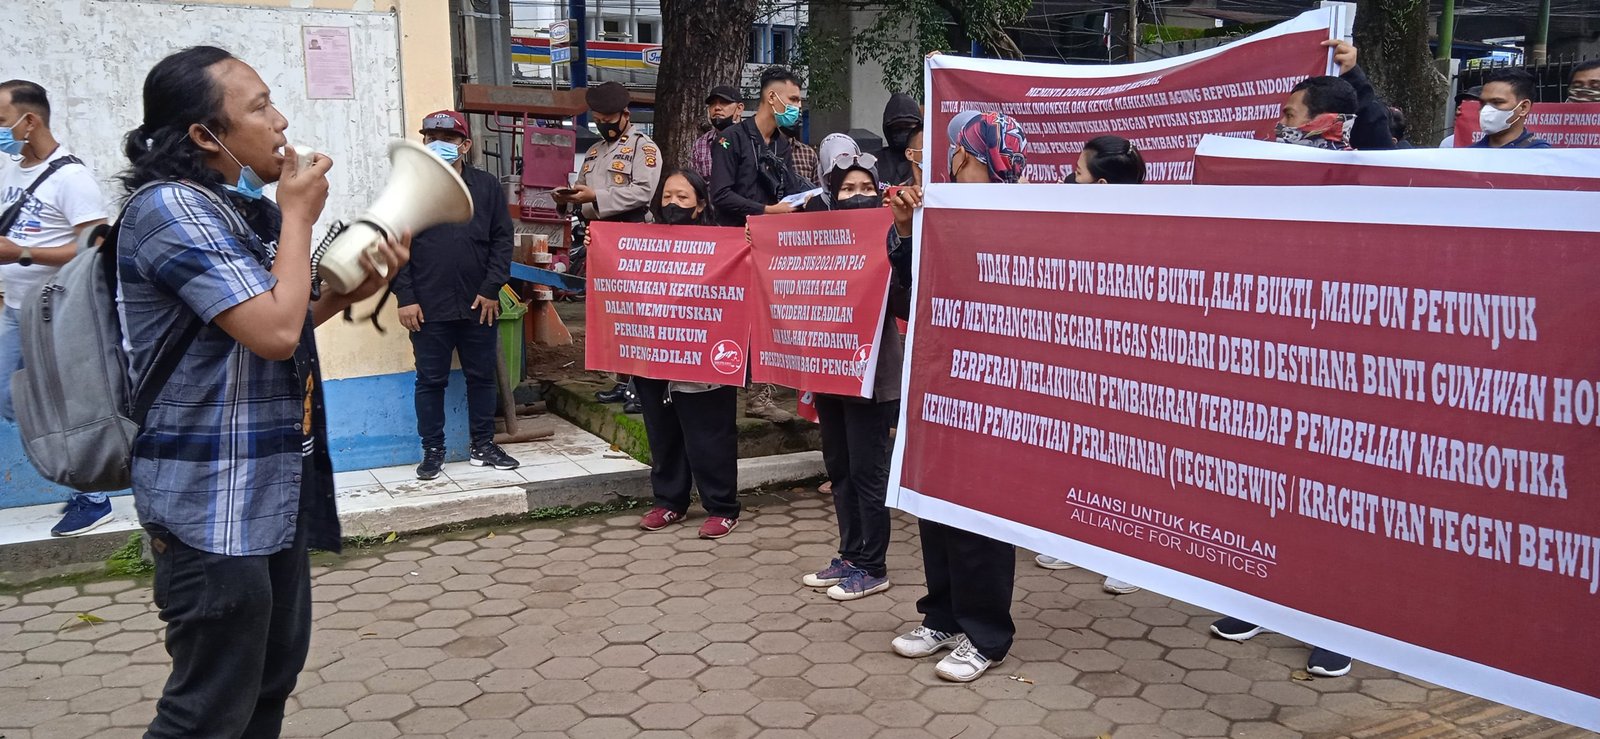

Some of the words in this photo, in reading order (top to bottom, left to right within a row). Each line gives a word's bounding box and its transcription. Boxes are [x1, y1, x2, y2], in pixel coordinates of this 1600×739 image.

[1032, 102, 1071, 115] INDONESIA
[1071, 101, 1088, 113] DAN
[1088, 99, 1114, 112] KETUA
[1114, 92, 1168, 110] MAHKAMAH
[1168, 88, 1201, 104] AGUNG
[1202, 81, 1256, 101] REPUBLIK
[1042, 122, 1058, 133] DAN
[1057, 119, 1111, 133] MEMUTUSKAN
[1110, 117, 1147, 131] DENGAN
[1147, 112, 1189, 128] PUTUSAN
[1189, 103, 1282, 125] SEBERAT-BERATNYA
[1539, 113, 1563, 126] SAKSI
[1129, 135, 1185, 151] PALEMBANG
[1564, 133, 1589, 146] SAKSI
[617, 237, 673, 253] GUNAKAN
[673, 240, 717, 255] HUKUM
[778, 230, 813, 247] PUTUSAN
[812, 228, 851, 246] PERKARA
[617, 258, 643, 273] DAN
[643, 260, 706, 276] BUKANLAH
[846, 254, 867, 271] PLG
[593, 277, 669, 296] MENGGUNAKAN
[668, 282, 745, 302] KEKUASAAN
[773, 279, 796, 299] WUJUD
[795, 279, 821, 295] NYATA
[820, 280, 848, 297] TELAH
[604, 300, 636, 315] DALAM
[636, 302, 723, 322] MEMUTUSKAN
[976, 252, 1010, 286] TIDAK
[1012, 255, 1035, 288] ADA
[1036, 257, 1067, 291] SATU
[1068, 259, 1095, 295] PUN
[1096, 262, 1155, 301] BARANG
[1210, 271, 1254, 312] ALAT
[1319, 280, 1408, 330] MAUPUN
[1411, 288, 1537, 350] PETUNJUK
[810, 305, 854, 323] KEADILAN
[614, 322, 656, 340] PERKARA
[657, 326, 708, 344] HUKUM
[806, 330, 860, 351] TERDAKWA
[619, 344, 630, 360] DI
[630, 346, 703, 366] PENGADILAN
[800, 356, 821, 374] BAGI
[931, 297, 961, 328] YANG
[961, 300, 1052, 343] MENERANGKAN
[1054, 312, 1103, 351] SECARA
[1104, 319, 1149, 359] TEGAS
[1150, 325, 1215, 371] SAUDARI
[1218, 334, 1260, 378] DEBI
[1263, 340, 1358, 393] DESTIANA
[1362, 353, 1426, 403] BINTI
[1431, 362, 1547, 422] GUNAWAN
[950, 348, 1020, 390] BERPERAN
[1020, 360, 1097, 407] MELAKUKAN
[1098, 373, 1198, 428] PEMBAYARAN
[1199, 393, 1293, 446] TERHADAP
[1294, 412, 1417, 474] PEMBELIAN
[1417, 433, 1568, 500] NARKOTIKA
[921, 392, 983, 434] KEKUATAN
[982, 405, 1072, 455] PEMBUKTIAN
[1071, 424, 1167, 479] PERLAWANAN
[1168, 446, 1287, 519] (TEGENBEWIJS
[1289, 475, 1297, 514] /
[1298, 477, 1379, 535] KRACHT
[1381, 499, 1426, 546] VAN
[1429, 507, 1513, 565] TEGEN
[1518, 523, 1600, 595] BEWIJ
[1066, 487, 1127, 515] ALIANSI
[1130, 503, 1184, 531] UNTUK
[1189, 521, 1277, 560] KEADILAN
[1070, 508, 1144, 541] ALLIANCE
[1149, 529, 1182, 552] FOR
[1186, 542, 1268, 579] JUSTICES
